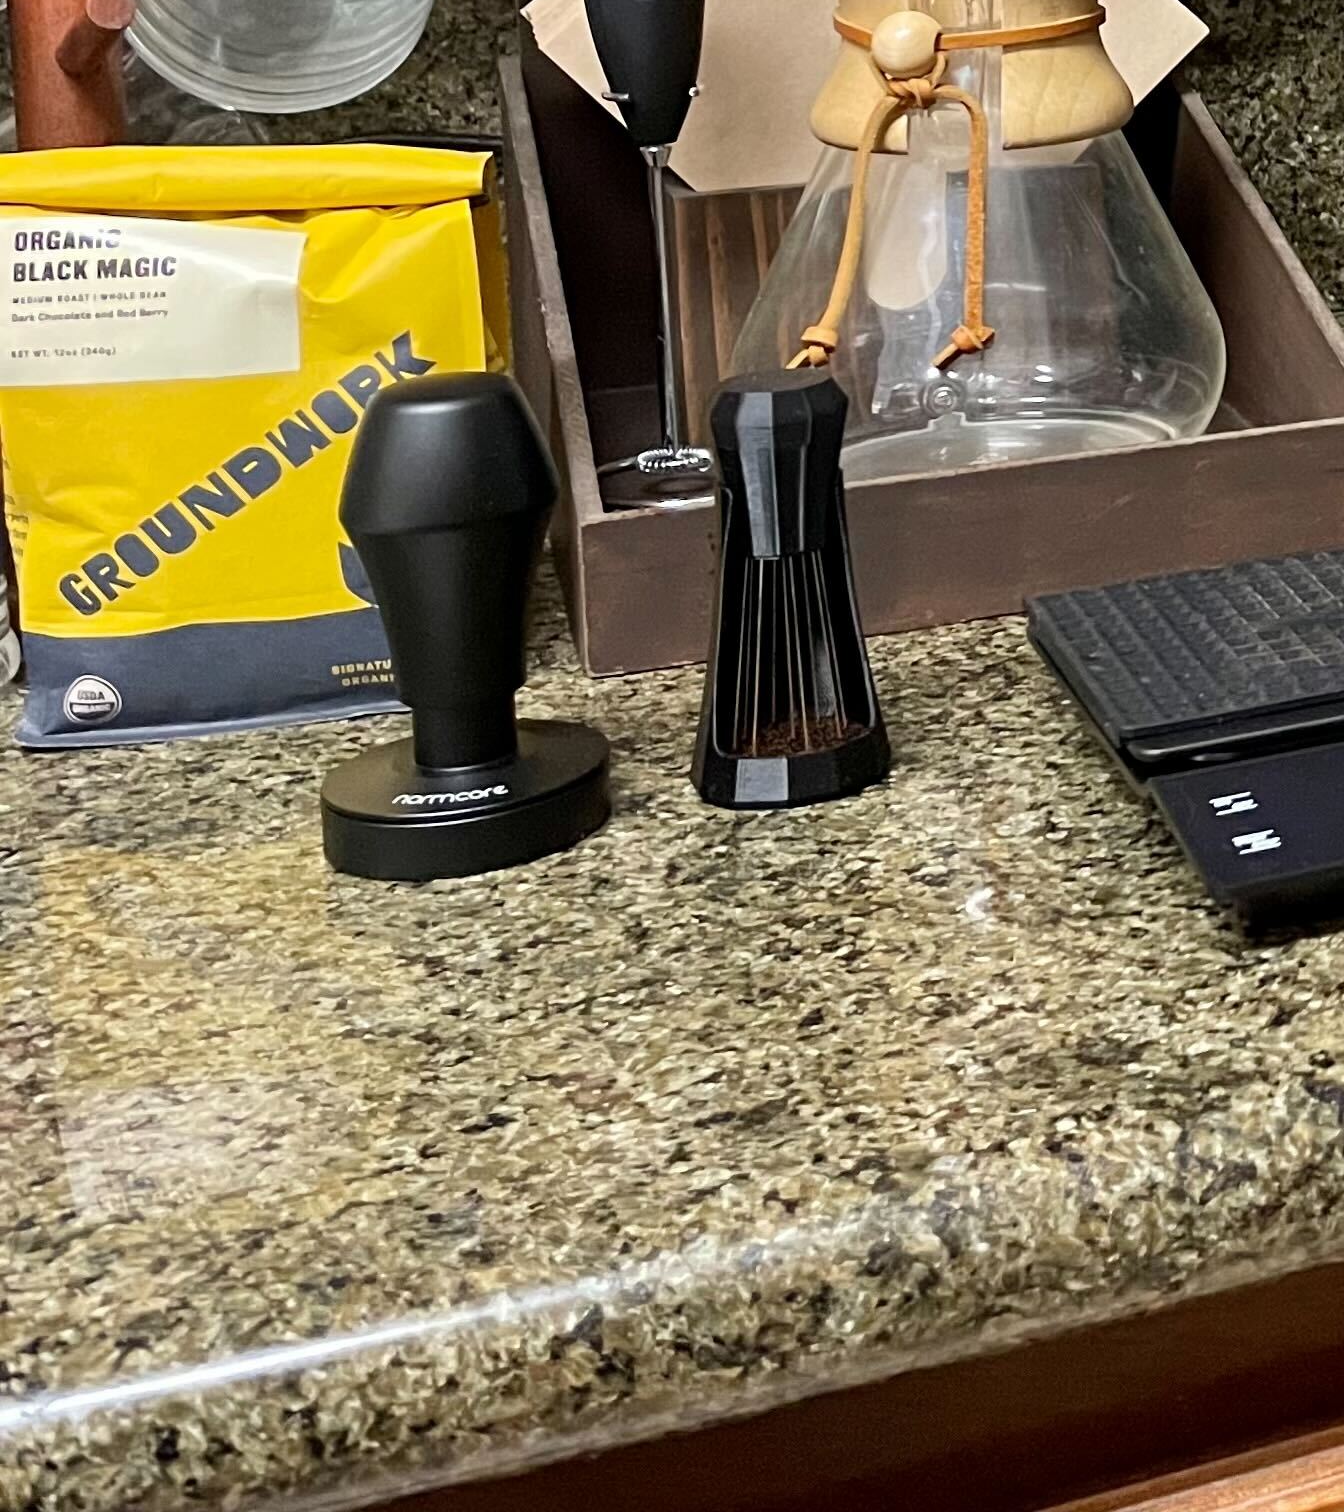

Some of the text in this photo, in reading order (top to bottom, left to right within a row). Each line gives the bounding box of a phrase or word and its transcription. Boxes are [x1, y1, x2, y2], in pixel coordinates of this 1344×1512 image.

[14, 229, 122, 252] ORGANIC
[13, 256, 178, 283] BLACK MAGIC
[59, 329, 438, 617] GROUNDWORK
[331, 658, 392, 676] SIGNATU
[341, 673, 395, 687] ORGANI
[77, 690, 106, 701] USDA
[391, 784, 509, 805] normcore
